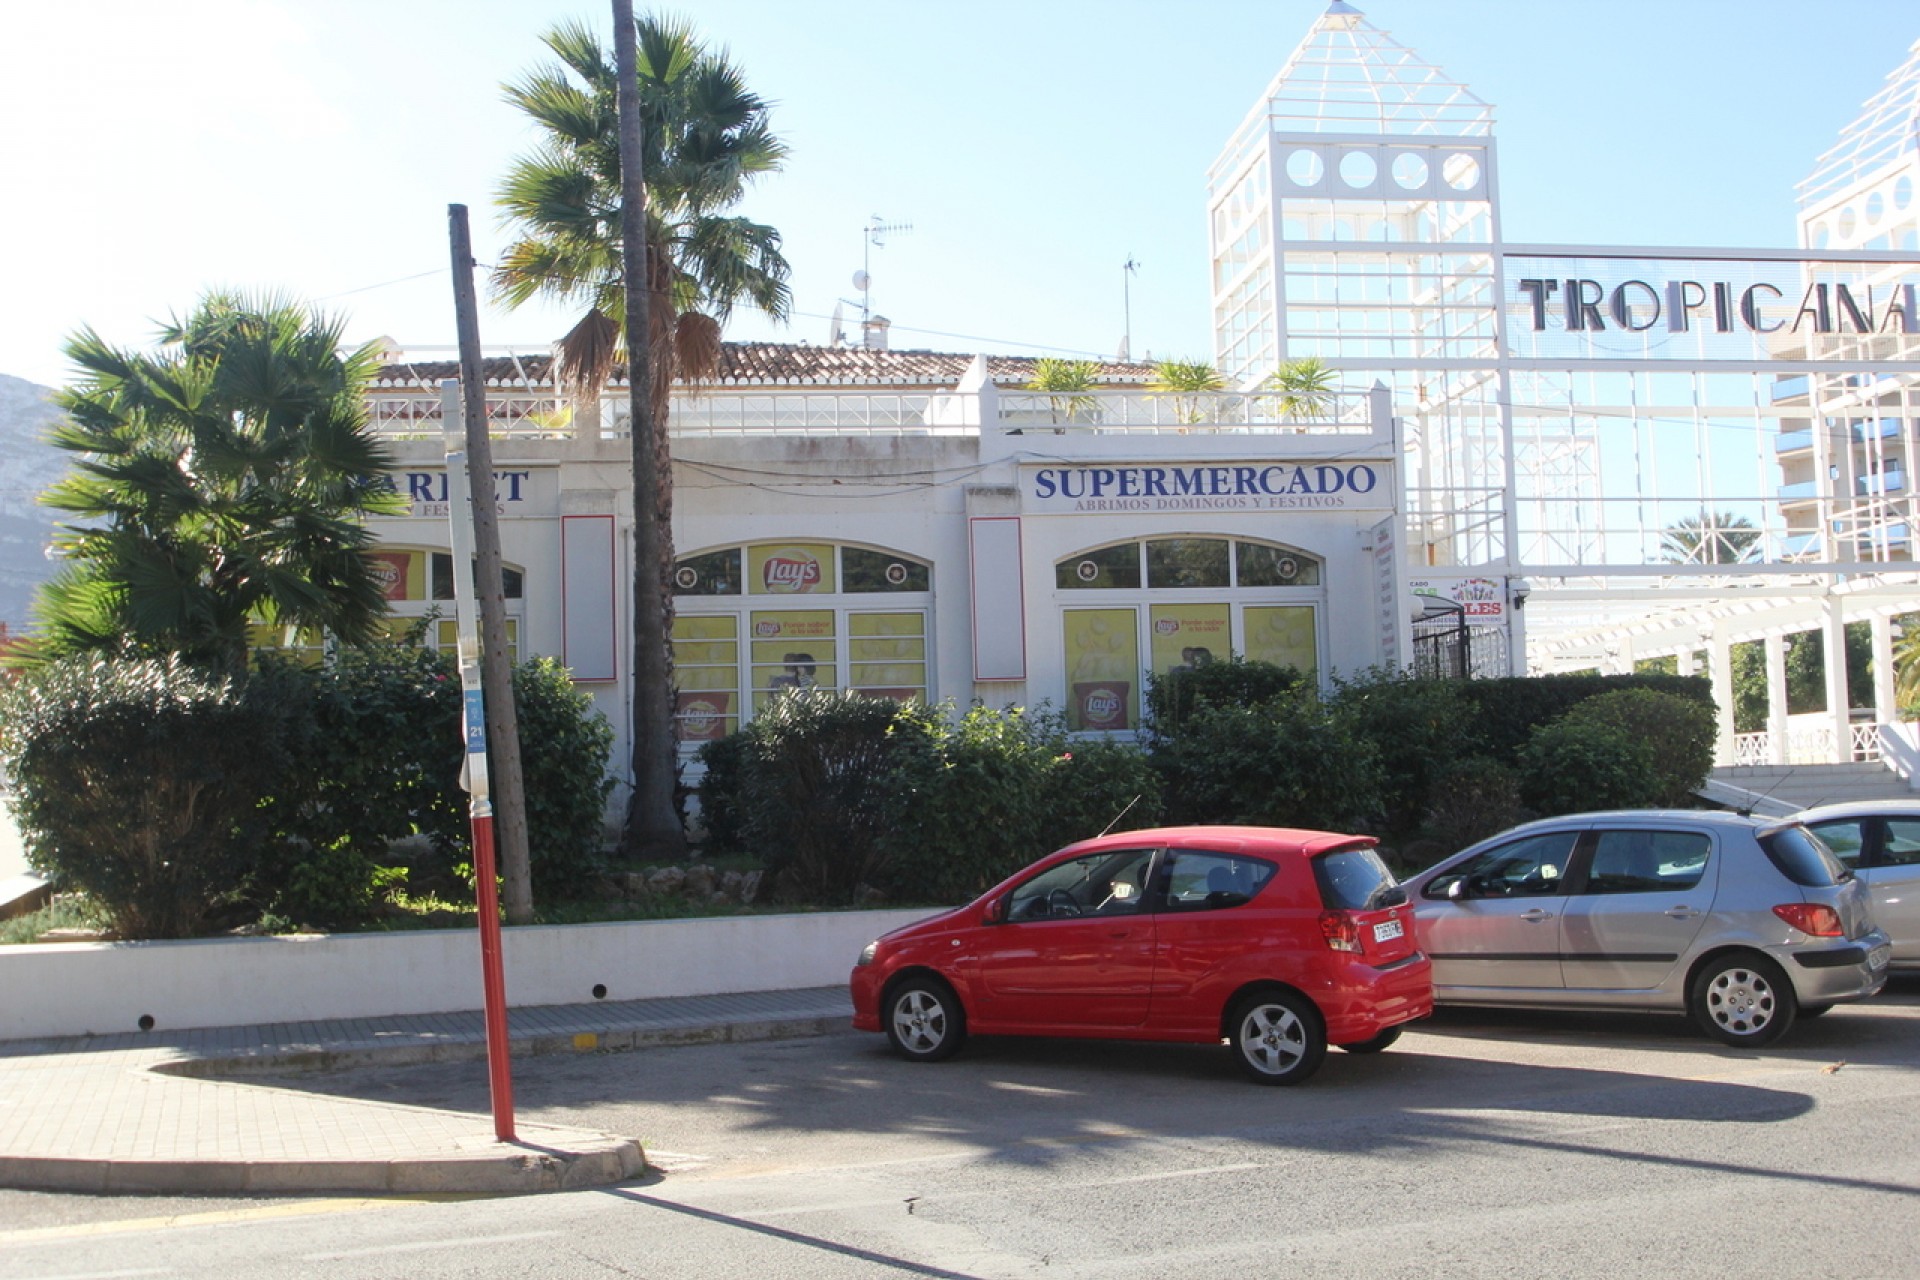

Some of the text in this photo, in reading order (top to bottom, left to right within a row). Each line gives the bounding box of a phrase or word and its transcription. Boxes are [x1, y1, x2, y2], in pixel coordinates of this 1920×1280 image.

[1518, 278, 1919, 334] TROPICANA
[1035, 464, 1377, 499] SUPERMERCADO
[1074, 495, 1345, 511] ABRIMOS DOMINGOS Y FESTIVOS
[471, 725, 483, 737] 21
